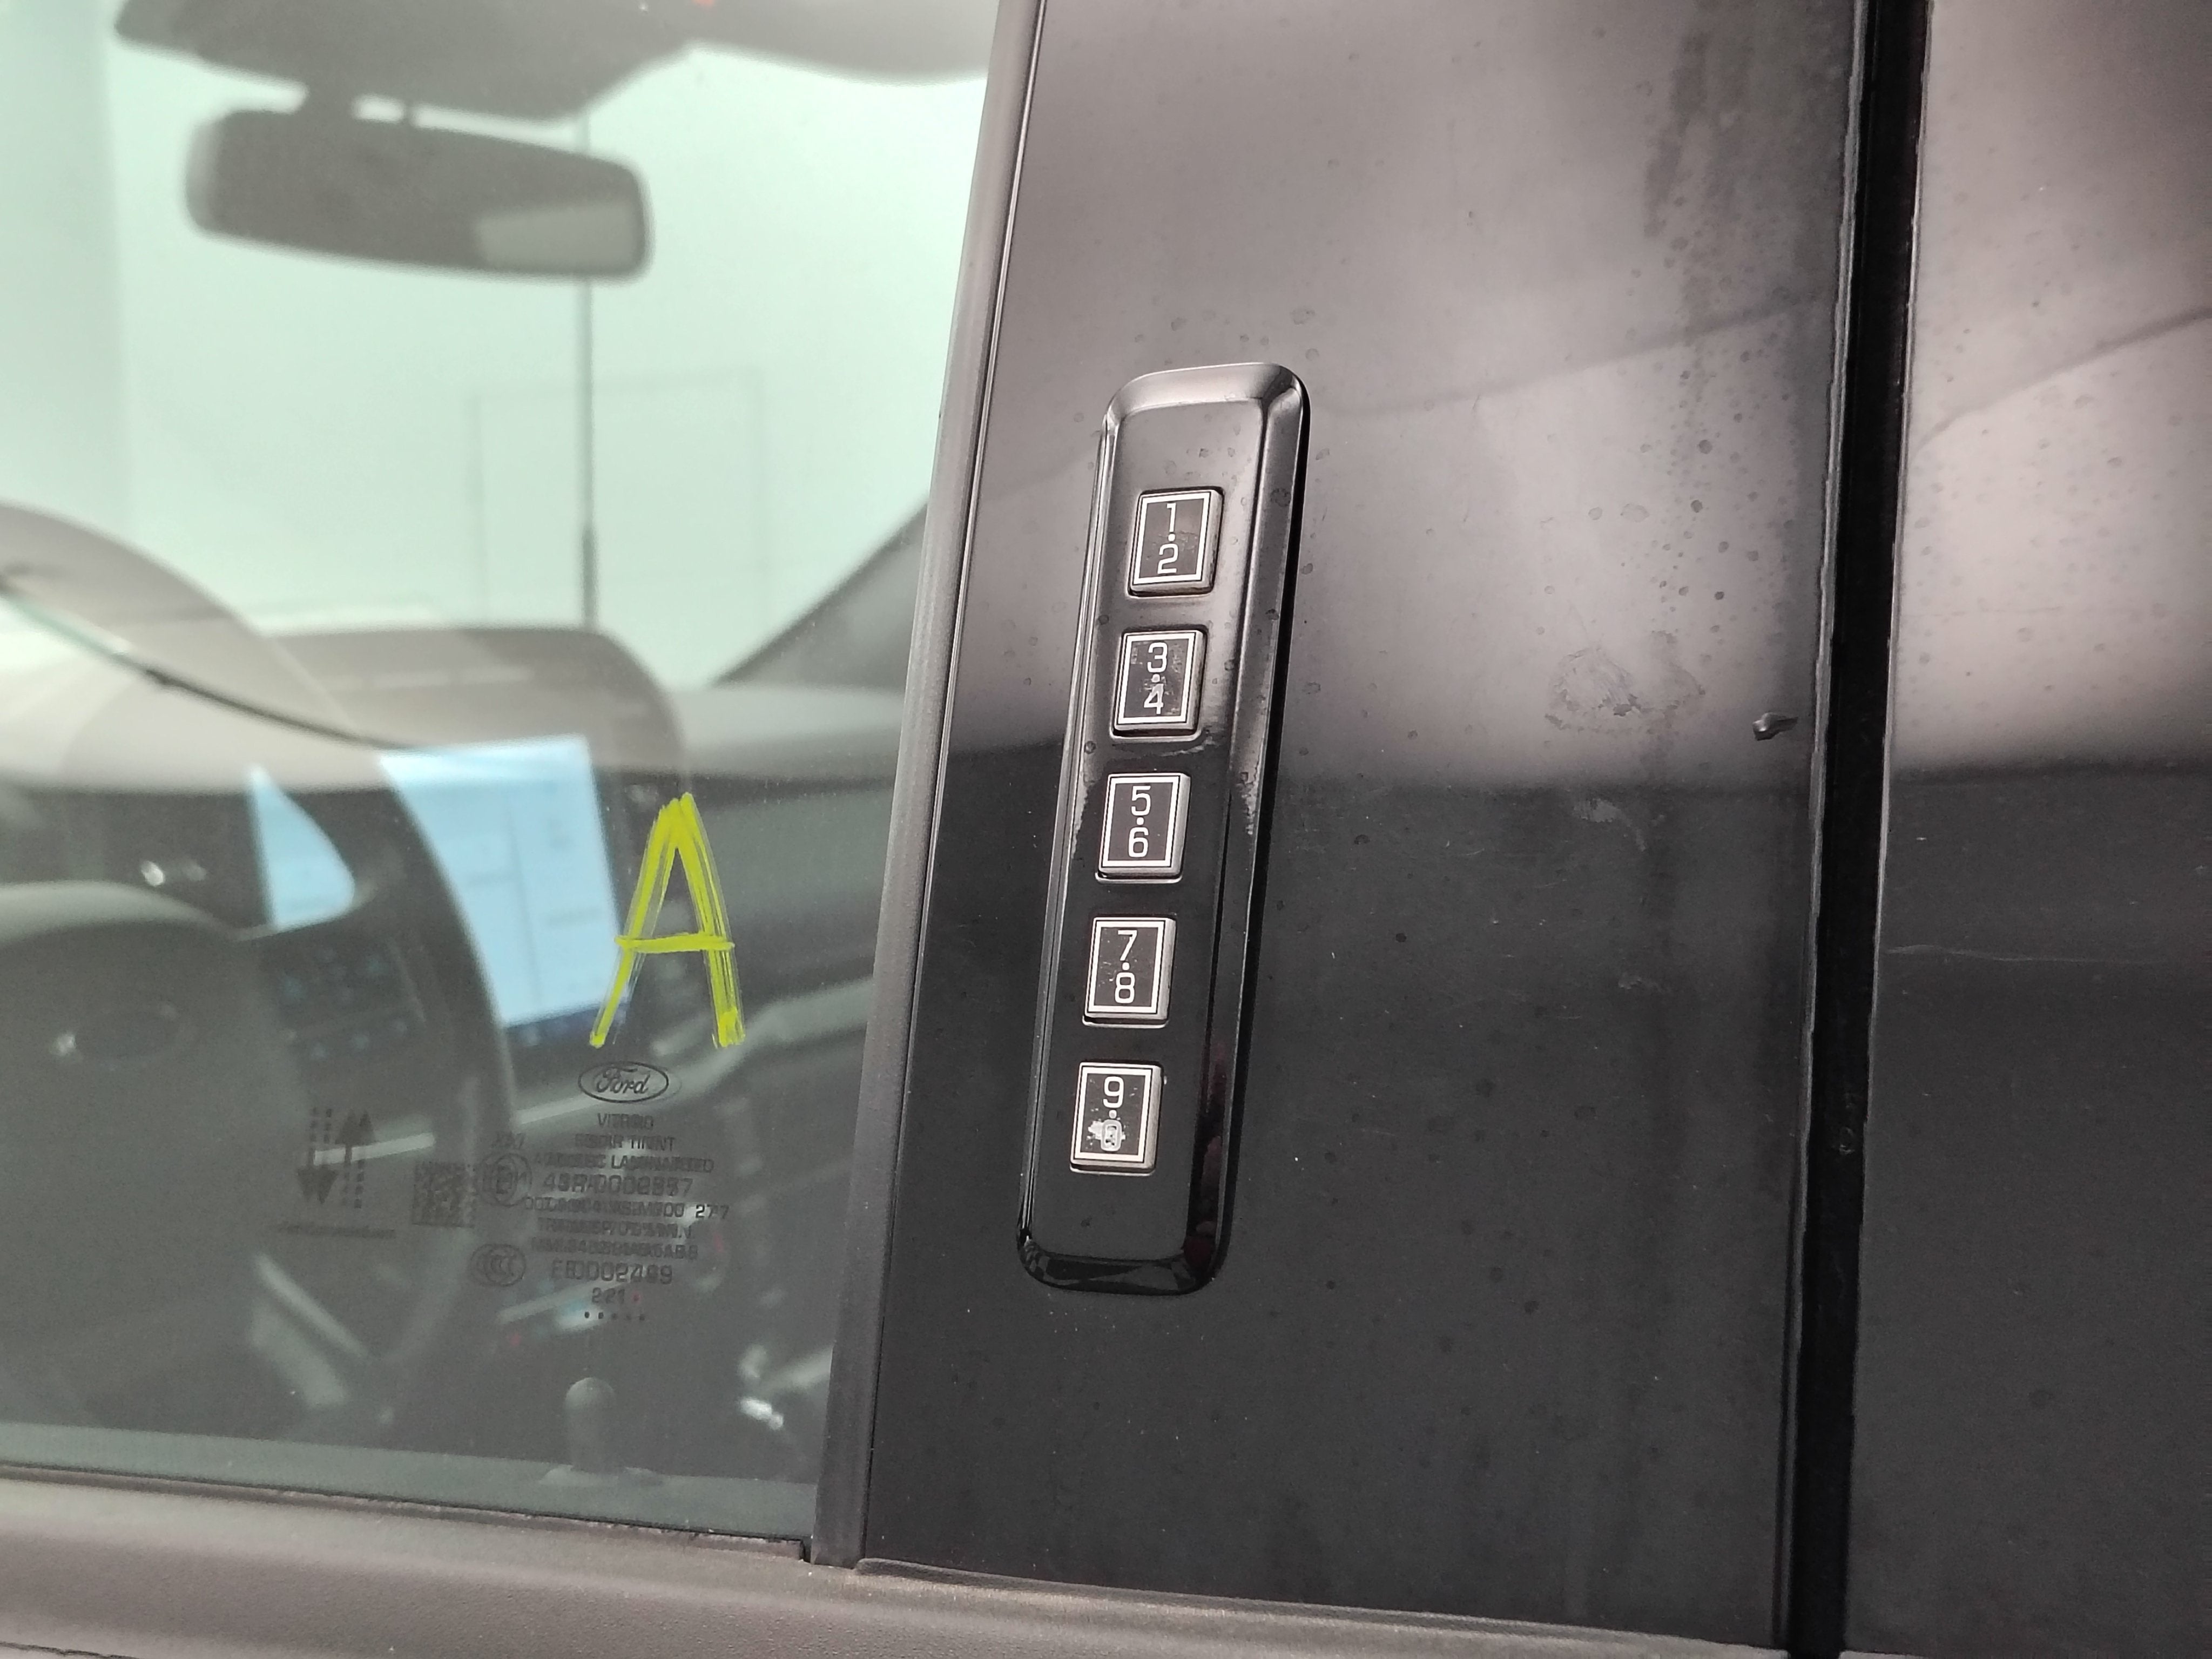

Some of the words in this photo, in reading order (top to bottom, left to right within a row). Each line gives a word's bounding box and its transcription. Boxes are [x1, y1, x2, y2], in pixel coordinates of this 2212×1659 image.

[1166, 502, 1177, 531] 1
[1157, 543, 1178, 575] 2
[1147, 642, 1168, 673] 3
[1143, 683, 1164, 714] 4
[1131, 785, 1151, 816] 5
[1128, 827, 1149, 858] 6
[590, 792, 745, 1048] A
[1118, 930, 1137, 961] 7
[1115, 972, 1135, 1003] 8
[596, 1066, 650, 1094] Ford
[1103, 1076, 1124, 1108] 9
